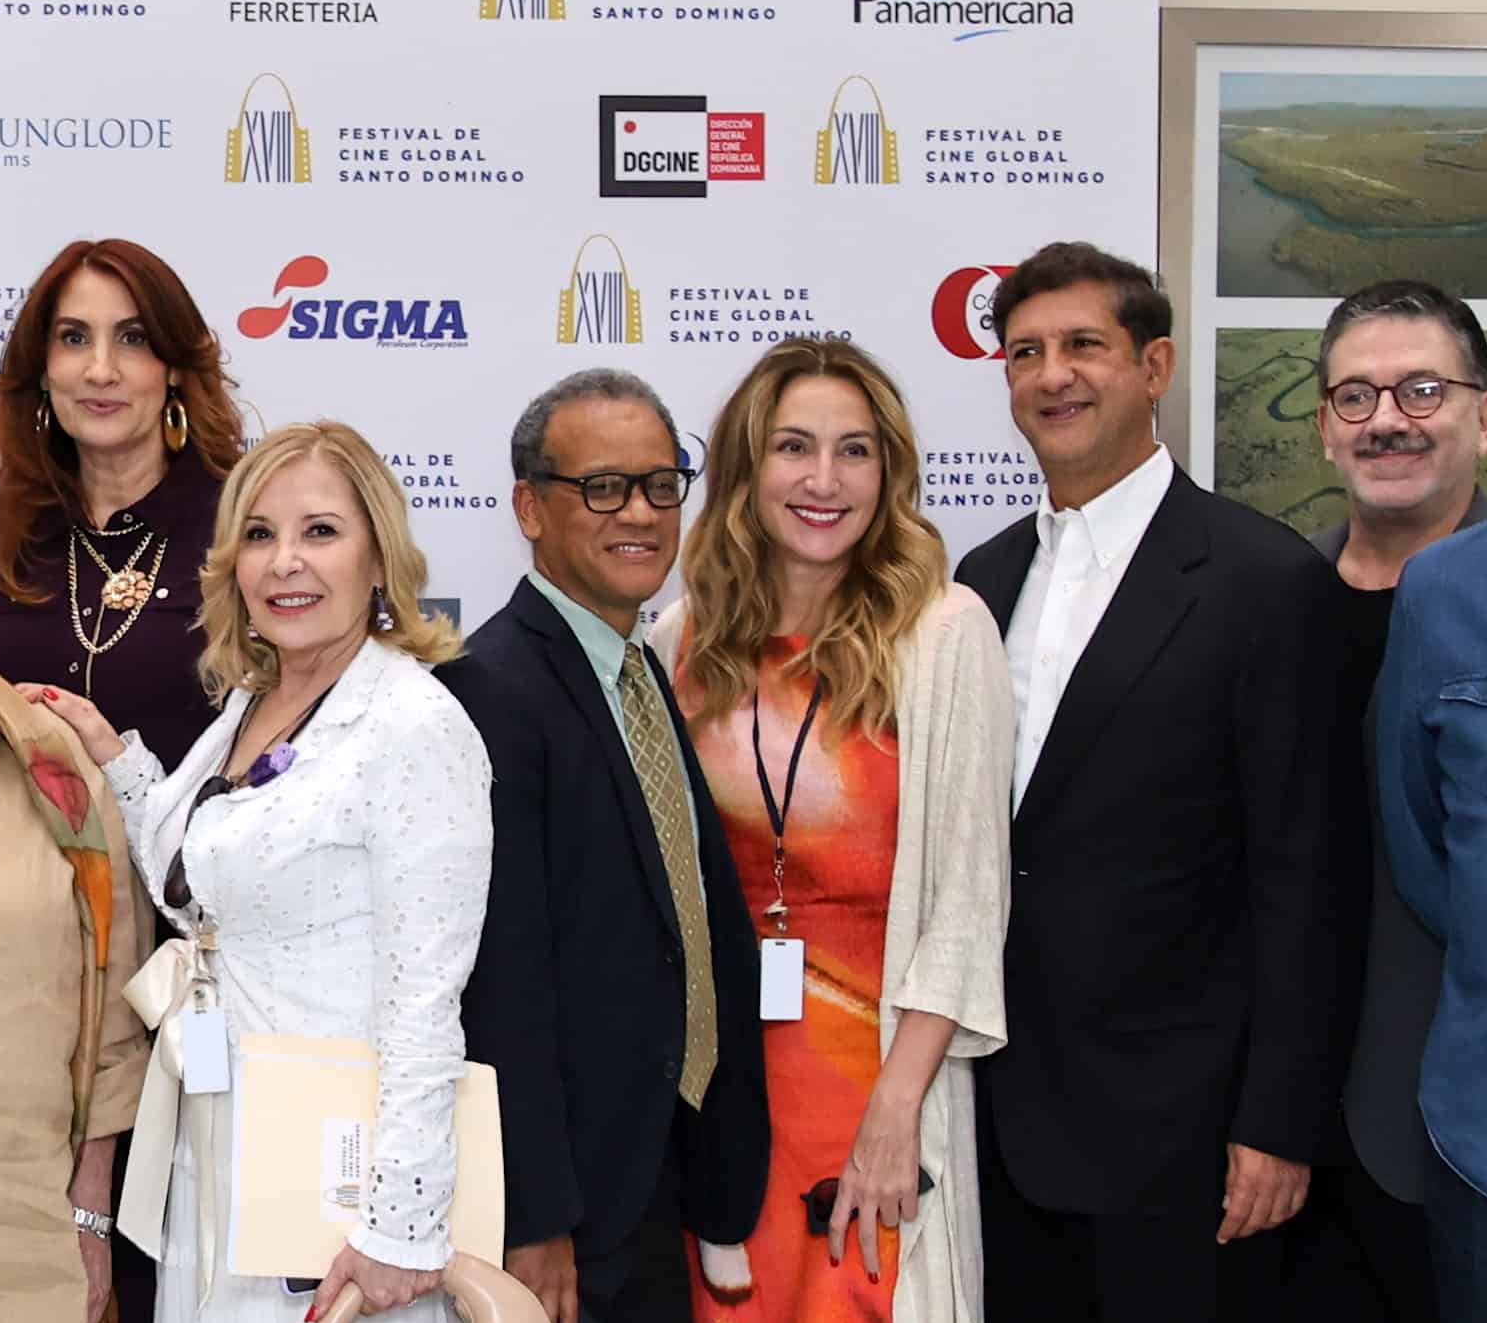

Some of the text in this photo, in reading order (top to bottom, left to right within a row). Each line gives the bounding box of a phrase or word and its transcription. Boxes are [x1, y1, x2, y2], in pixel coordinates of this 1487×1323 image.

[230, 2, 378, 22] FERRETERIA
[592, 6, 776, 21] SANTO DOMINGO
[925, 129, 1062, 142] FESTIVAL DE
[624, 151, 700, 173] DGCINE
[925, 150, 1068, 163] CINE GLOBAL
[925, 171, 1105, 184] SANTO DOMINGO
[669, 288, 809, 301] FESTIVAL DE
[288, 300, 468, 340] SIGMA
[669, 309, 814, 322] CINE GLOBAL
[669, 330, 740, 343] SANTO
[428, 454, 455, 467] DE
[926, 453, 1026, 465] FESTIVAL
[402, 475, 461, 488] OBAL
[926, 473, 1042, 486] CINE GLOB
[411, 496, 498, 509] OMINGO
[926, 494, 995, 507] SANTO
